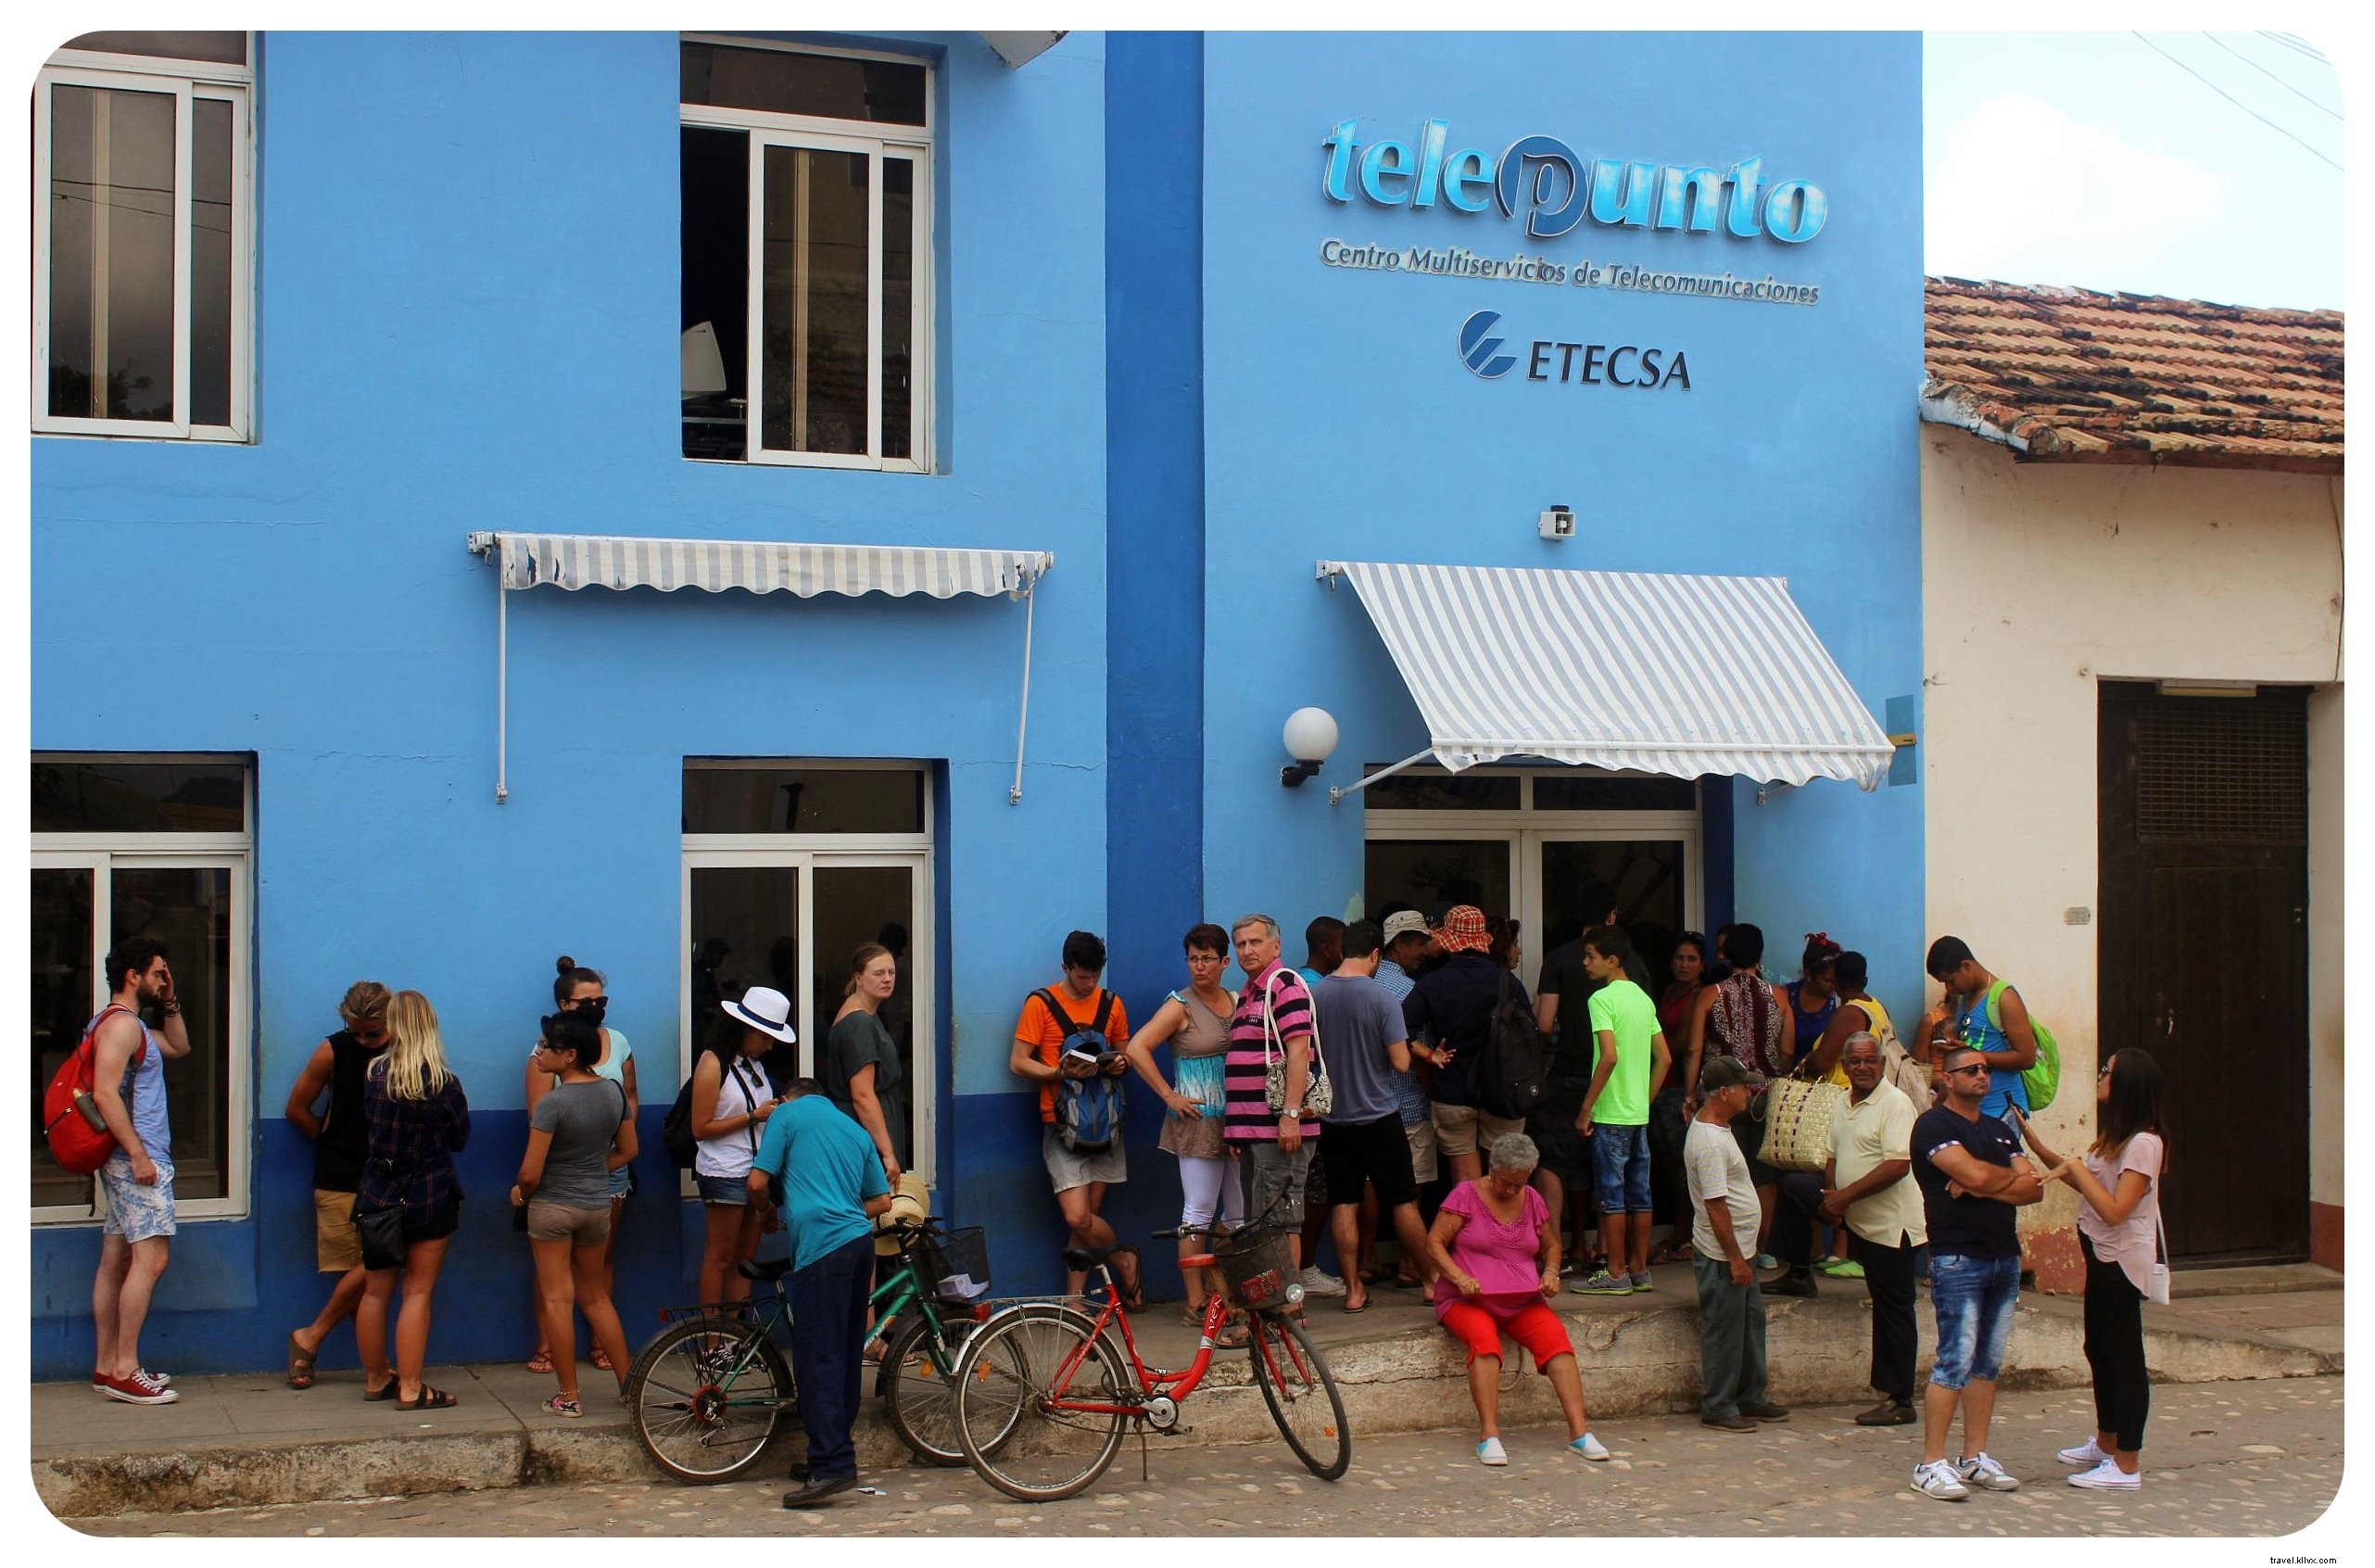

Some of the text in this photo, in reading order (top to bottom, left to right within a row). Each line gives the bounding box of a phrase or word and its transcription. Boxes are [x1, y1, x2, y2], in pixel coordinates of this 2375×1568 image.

[1322, 118, 1828, 245] telepunto
[1322, 239, 1819, 305] Centro Multiservicios de Telecomunicaciones
[1525, 340, 1692, 392] ETECSA
